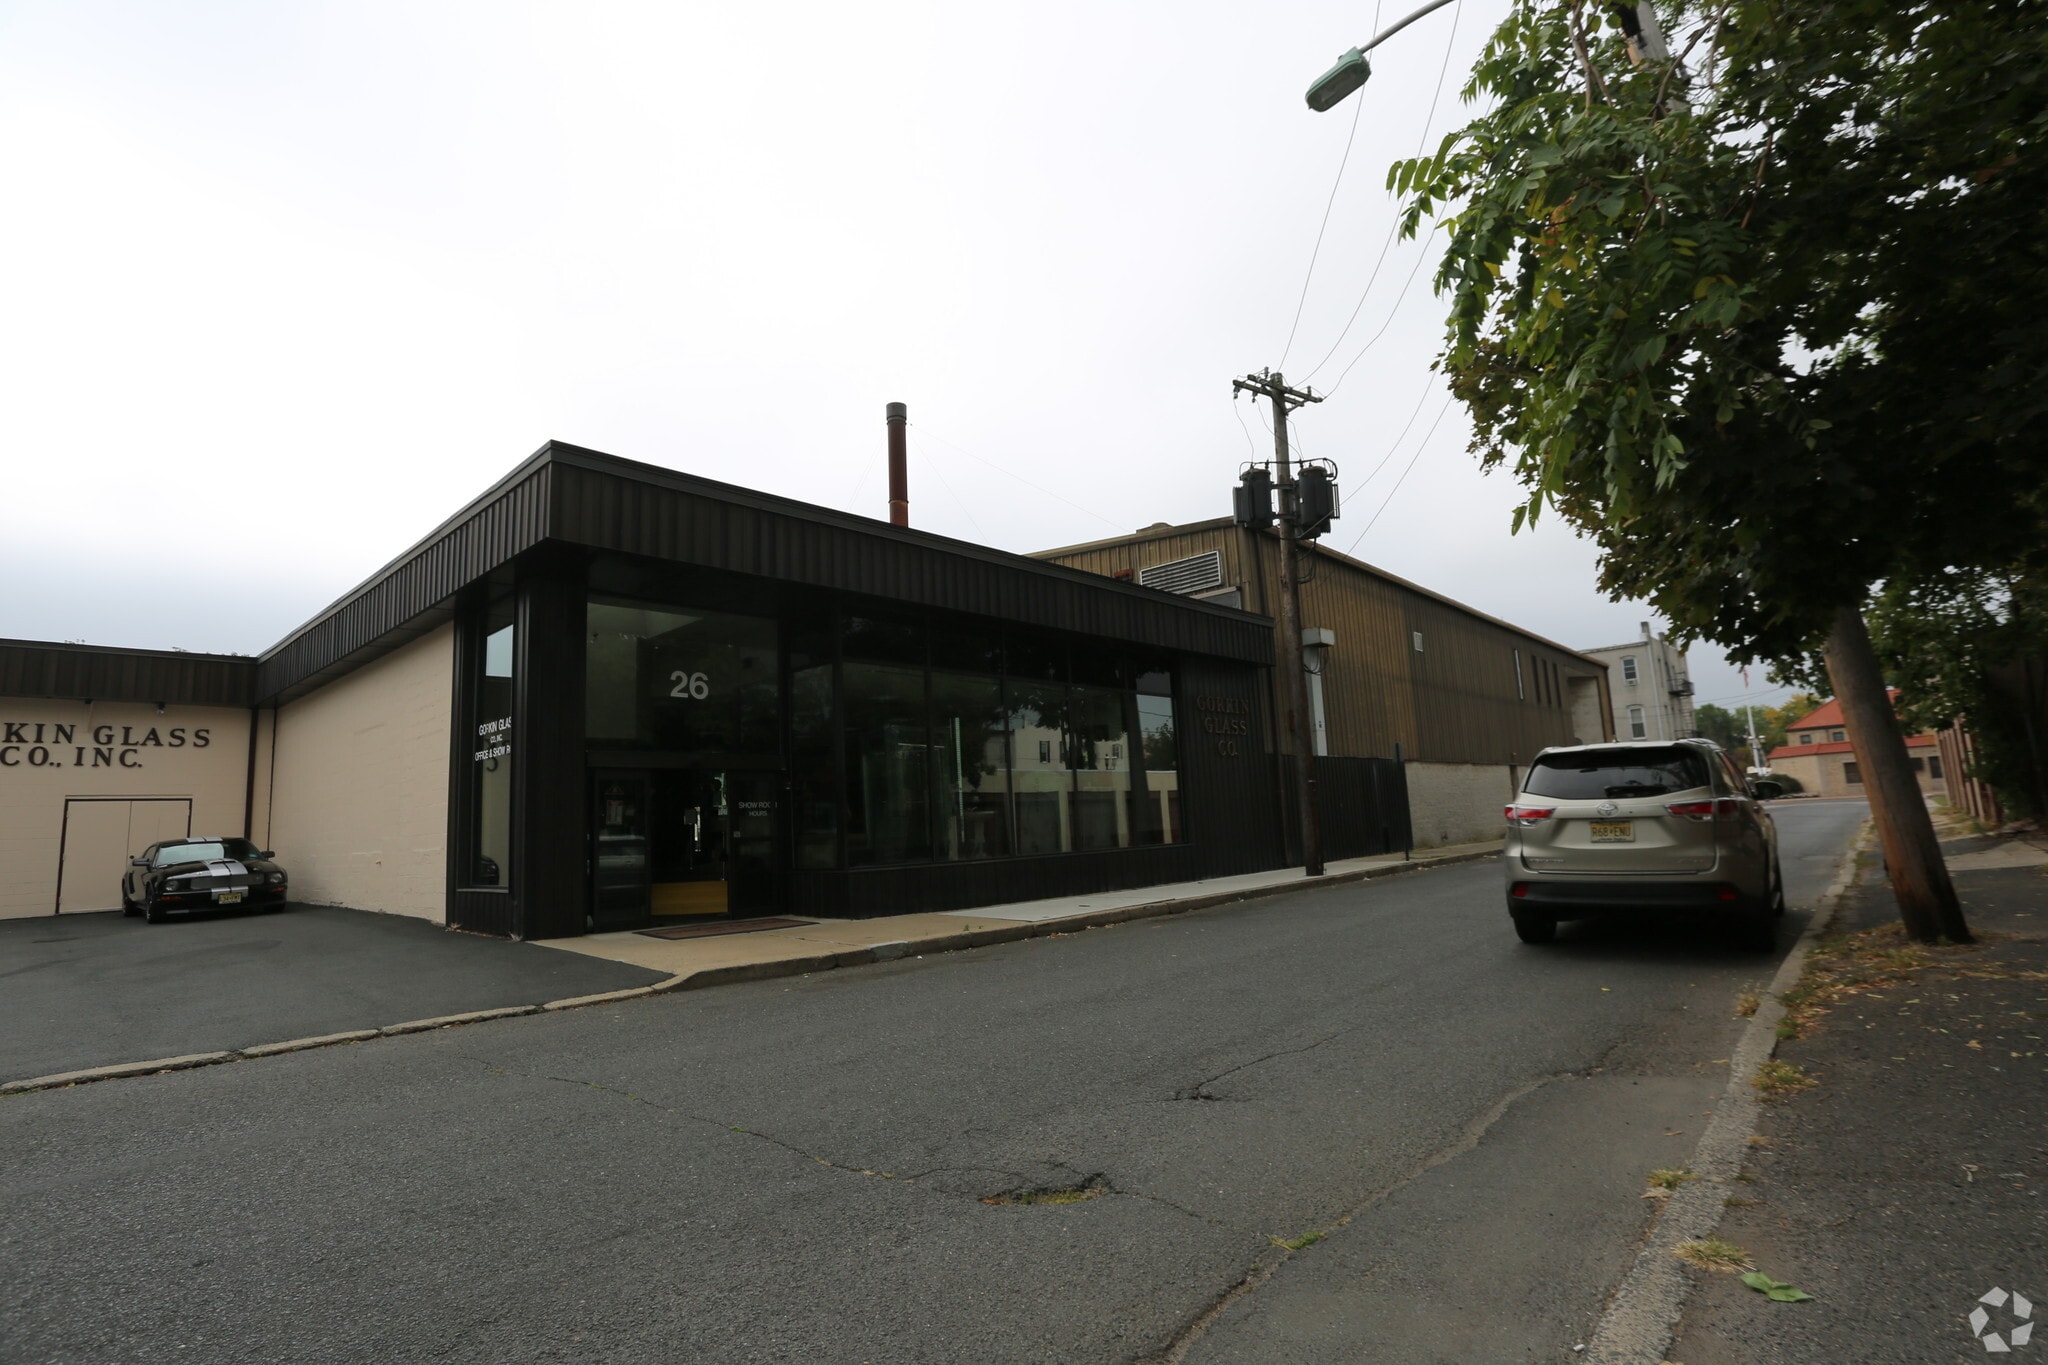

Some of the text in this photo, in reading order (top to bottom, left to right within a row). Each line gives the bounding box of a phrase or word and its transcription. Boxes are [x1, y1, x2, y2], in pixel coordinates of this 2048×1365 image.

[670, 670, 709, 700] 26
[1196, 695, 1249, 714] GORKIN
[1, 722, 210, 748] KIN GLASS
[1204, 717, 1247, 735] GLASS
[73, 746, 143, 768] INC.
[474, 749, 489, 761] OFFICE
[493, 745, 506, 757] SHOW
[738, 801, 758, 809] SHOW
